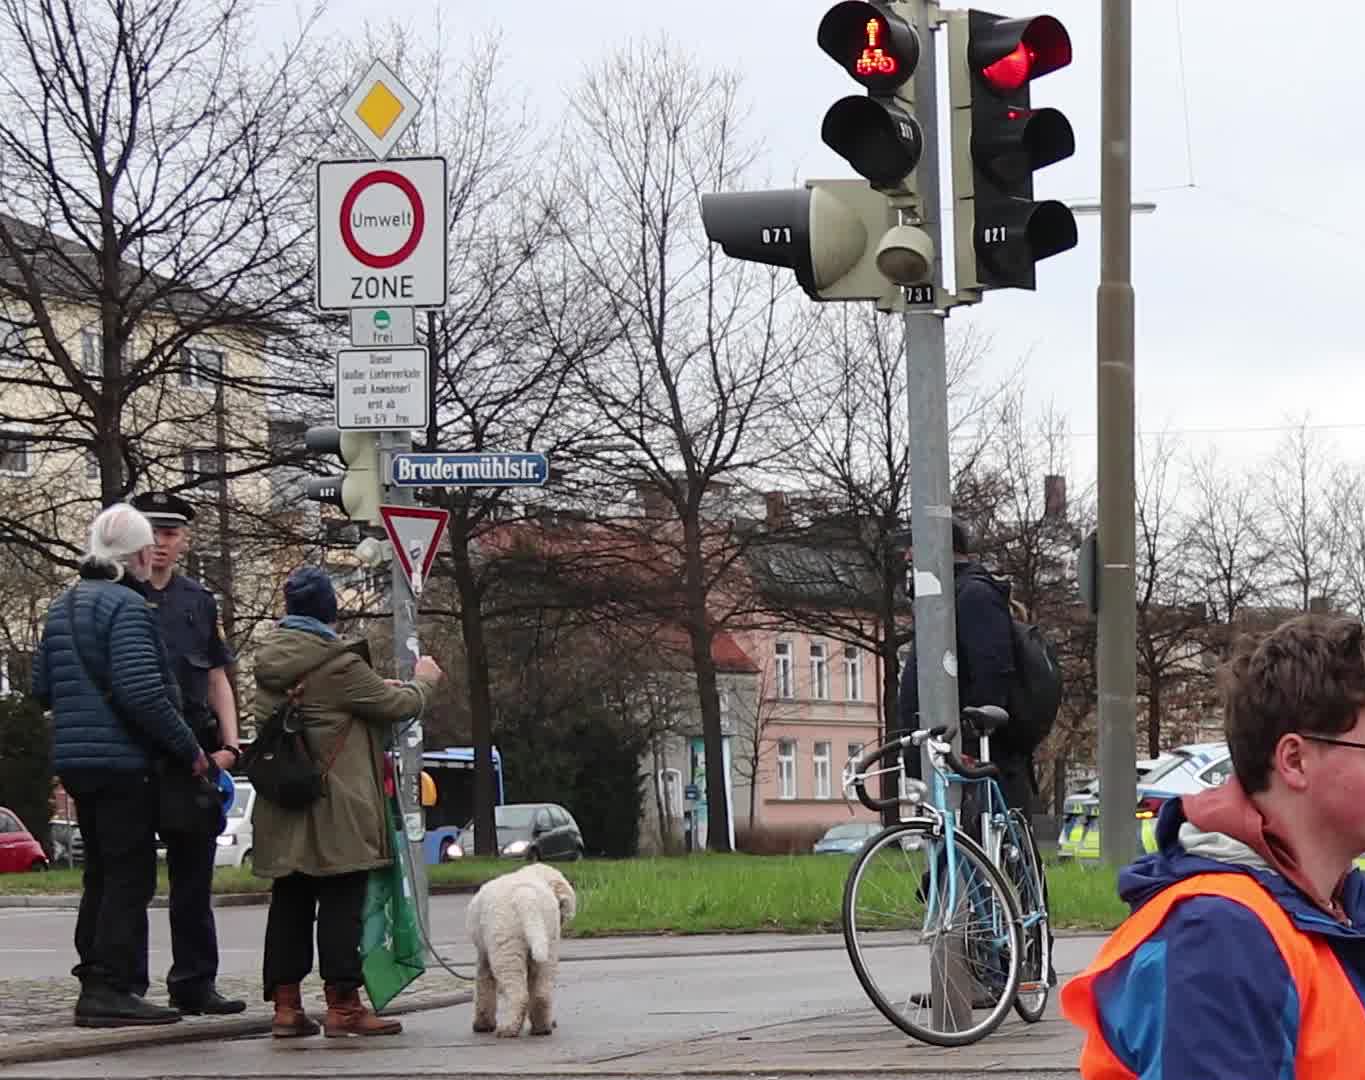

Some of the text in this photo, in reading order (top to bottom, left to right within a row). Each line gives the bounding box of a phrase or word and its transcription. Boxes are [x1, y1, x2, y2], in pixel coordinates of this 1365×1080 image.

[352, 210, 412, 228] Umwelt
[762, 228, 791, 243] 071
[984, 226, 1006, 243] 021
[351, 275, 414, 299] ZONE
[906, 287, 932, 301] 731
[373, 332, 393, 343] frei
[398, 457, 540, 480] Brudermühlstr.
